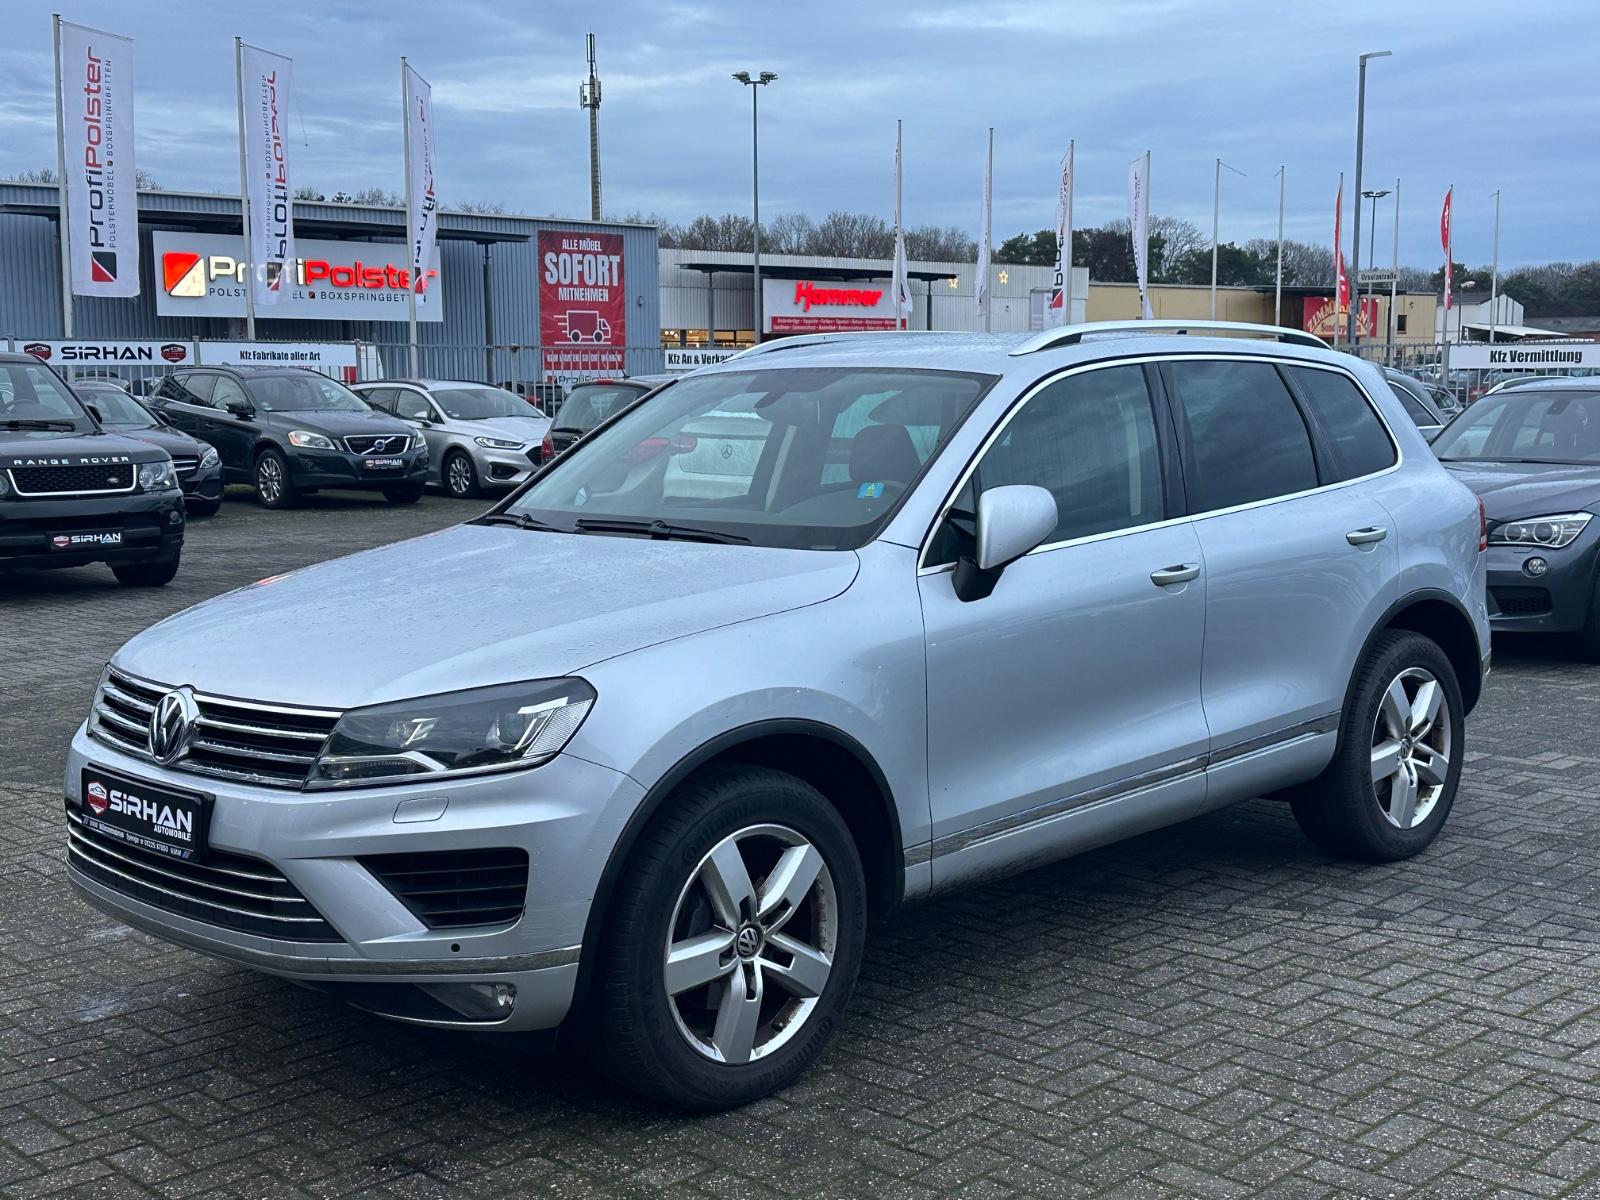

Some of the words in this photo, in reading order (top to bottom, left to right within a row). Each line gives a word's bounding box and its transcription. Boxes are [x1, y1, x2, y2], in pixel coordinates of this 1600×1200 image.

[105, 60, 113, 156] BOXSPRINGBETTEN
[83, 46, 105, 248] ProfiPolster
[108, 169, 116, 248] POLSTERMÖBEL
[562, 238, 578, 250] ALLE
[579, 237, 602, 251] MÖBEL
[544, 252, 620, 286] SOFORT
[558, 287, 609, 302] MITNEHMEN
[794, 280, 883, 312] Hammer
[240, 350, 252, 360] Kfz
[252, 350, 289, 360] Fabrikate
[290, 351, 308, 360] aller
[309, 351, 321, 360] Art
[668, 353, 680, 365] Kfz
[682, 353, 692, 365] An
[693, 354, 700, 365] &
[1489, 350, 1507, 363] Kfz
[1509, 349, 1583, 363] Vermittlung
[13, 458, 70, 466] RANGE
[80, 456, 129, 464] ROVER
[153, 824, 192, 841] AUTOMOBILE
